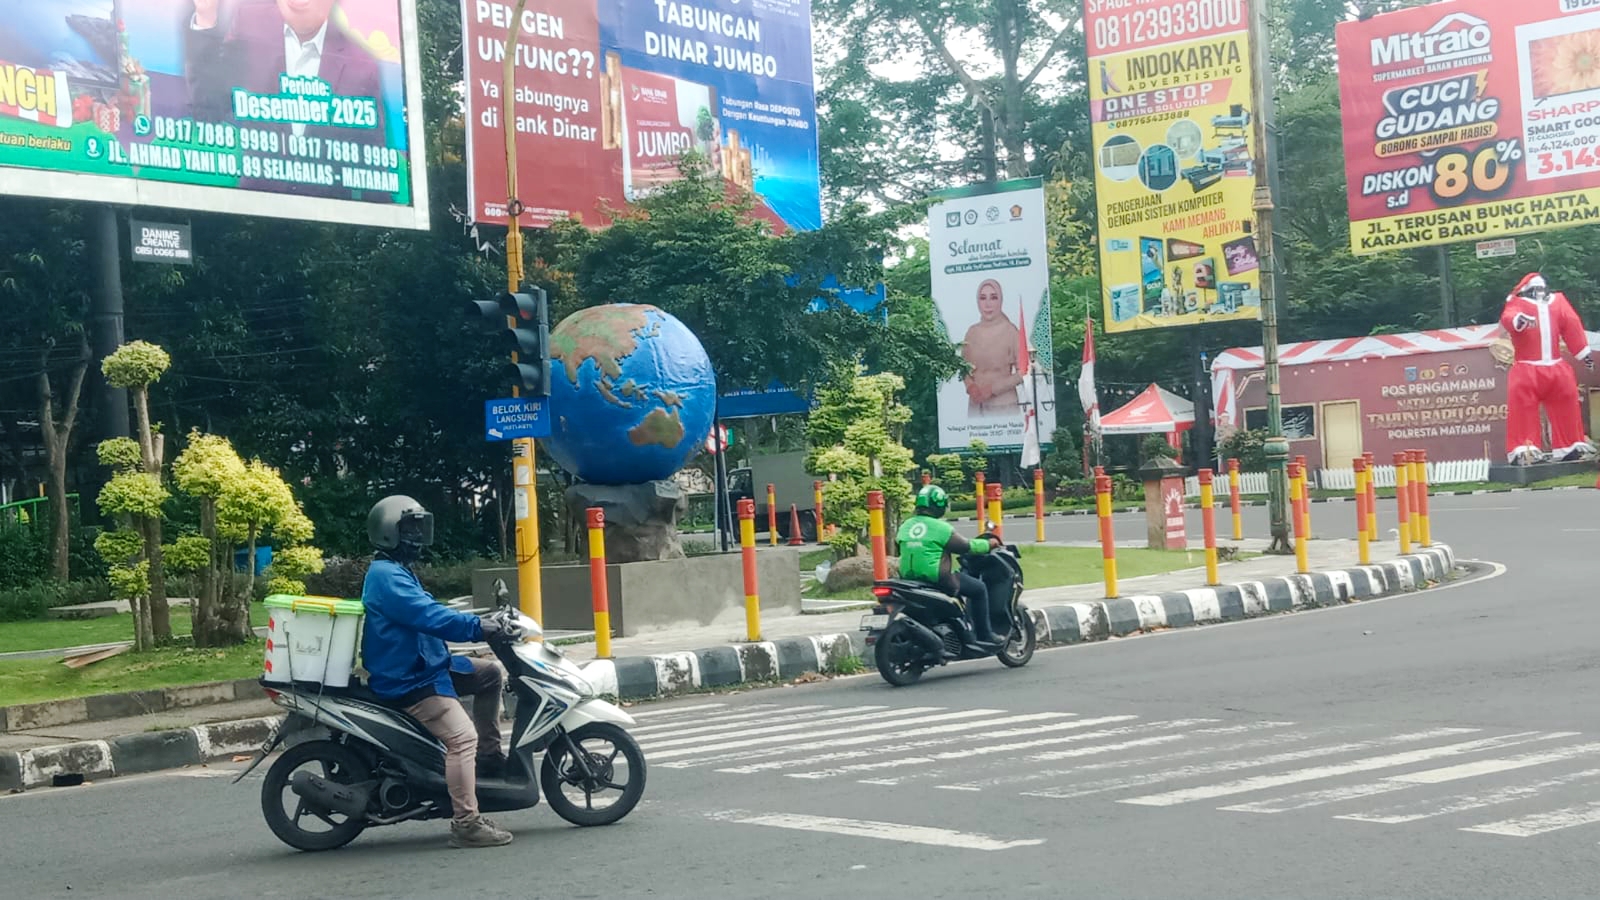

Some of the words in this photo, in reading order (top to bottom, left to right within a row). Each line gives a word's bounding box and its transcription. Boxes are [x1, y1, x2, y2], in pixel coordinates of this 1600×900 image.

[655, 1, 760, 42] TABUNGAN
[1094, 0, 1241, 49] 08123933000
[478, 36, 595, 79] UNTUNG??
[644, 31, 708, 65] DINAR
[713, 45, 777, 77] JUMBO
[1126, 40, 1240, 82] INDOKARYA
[281, 76, 330, 97] Periode:
[1128, 65, 1242, 92] ADVERTISING
[1373, 65, 1425, 82] SUPERMARKET
[0, 65, 57, 117] NCH
[515, 86, 589, 115] abungnya
[1106, 93, 1147, 112] ONE
[1154, 82, 1213, 104] STOP
[1400, 78, 1469, 110] CUCI
[234, 89, 329, 123] Desember
[331, 98, 376, 126] 2025
[1107, 106, 1153, 121] PRINTING
[1155, 98, 1208, 112] SOLUTION
[1376, 98, 1498, 138] GUDANG
[1527, 100, 1600, 121] SHARP
[481, 107, 498, 127] di
[516, 114, 548, 135] ank
[553, 118, 597, 141] Dinar
[1528, 120, 1571, 136] SMART
[28, 135, 71, 151] berlaku
[155, 116, 191, 142] 0817
[196, 121, 234, 148] 7088
[240, 127, 279, 153] 9989
[288, 134, 321, 159] 0817
[325, 139, 359, 164] 7688
[363, 144, 398, 169] 9989
[636, 131, 690, 157] JUMBO
[1381, 137, 1417, 154] BORONG
[1420, 131, 1458, 149] SAMPAI
[1460, 124, 1492, 143] HABIS!
[1540, 135, 1598, 151] 4.124.000
[108, 139, 127, 164] JL.
[129, 142, 181, 170] AHMAD
[184, 149, 215, 173] YANI
[218, 152, 241, 176] NO.
[242, 155, 261, 178] 89
[263, 158, 333, 185] SELAGALAS
[342, 166, 399, 192] MATARAM
[1363, 164, 1433, 195] DISKON
[1107, 193, 1162, 216] PENGERJAAN
[1108, 211, 1143, 228] DENGAN
[1144, 204, 1176, 221] SISTEM
[1178, 191, 1224, 213] KOMPUTER
[1387, 191, 1409, 208] s.d
[1163, 217, 1186, 233] KAMI
[1187, 208, 1226, 228] MEMANG
[1361, 229, 1432, 249] KARANG
[1438, 221, 1488, 240] BARU
[1504, 206, 1600, 230] MATARAM
[1368, 223, 1390, 235] JL.
[1394, 209, 1471, 230] TERUSAN
[1477, 200, 1525, 219] BUNG
[1530, 193, 1590, 212] HATTA
[142, 227, 180, 241] DANIMS
[1203, 220, 1241, 239] AHLINYA
[948, 239, 1003, 257] Selamat
[1382, 386, 1406, 397] POS
[1408, 377, 1496, 395] PENGAMANAN
[492, 404, 520, 415] BELOK
[523, 402, 541, 413] KIRI
[496, 412, 538, 423] LANGSUNG
[1388, 427, 1438, 440] POLRESTA
[1439, 423, 1491, 435] MATARAM
